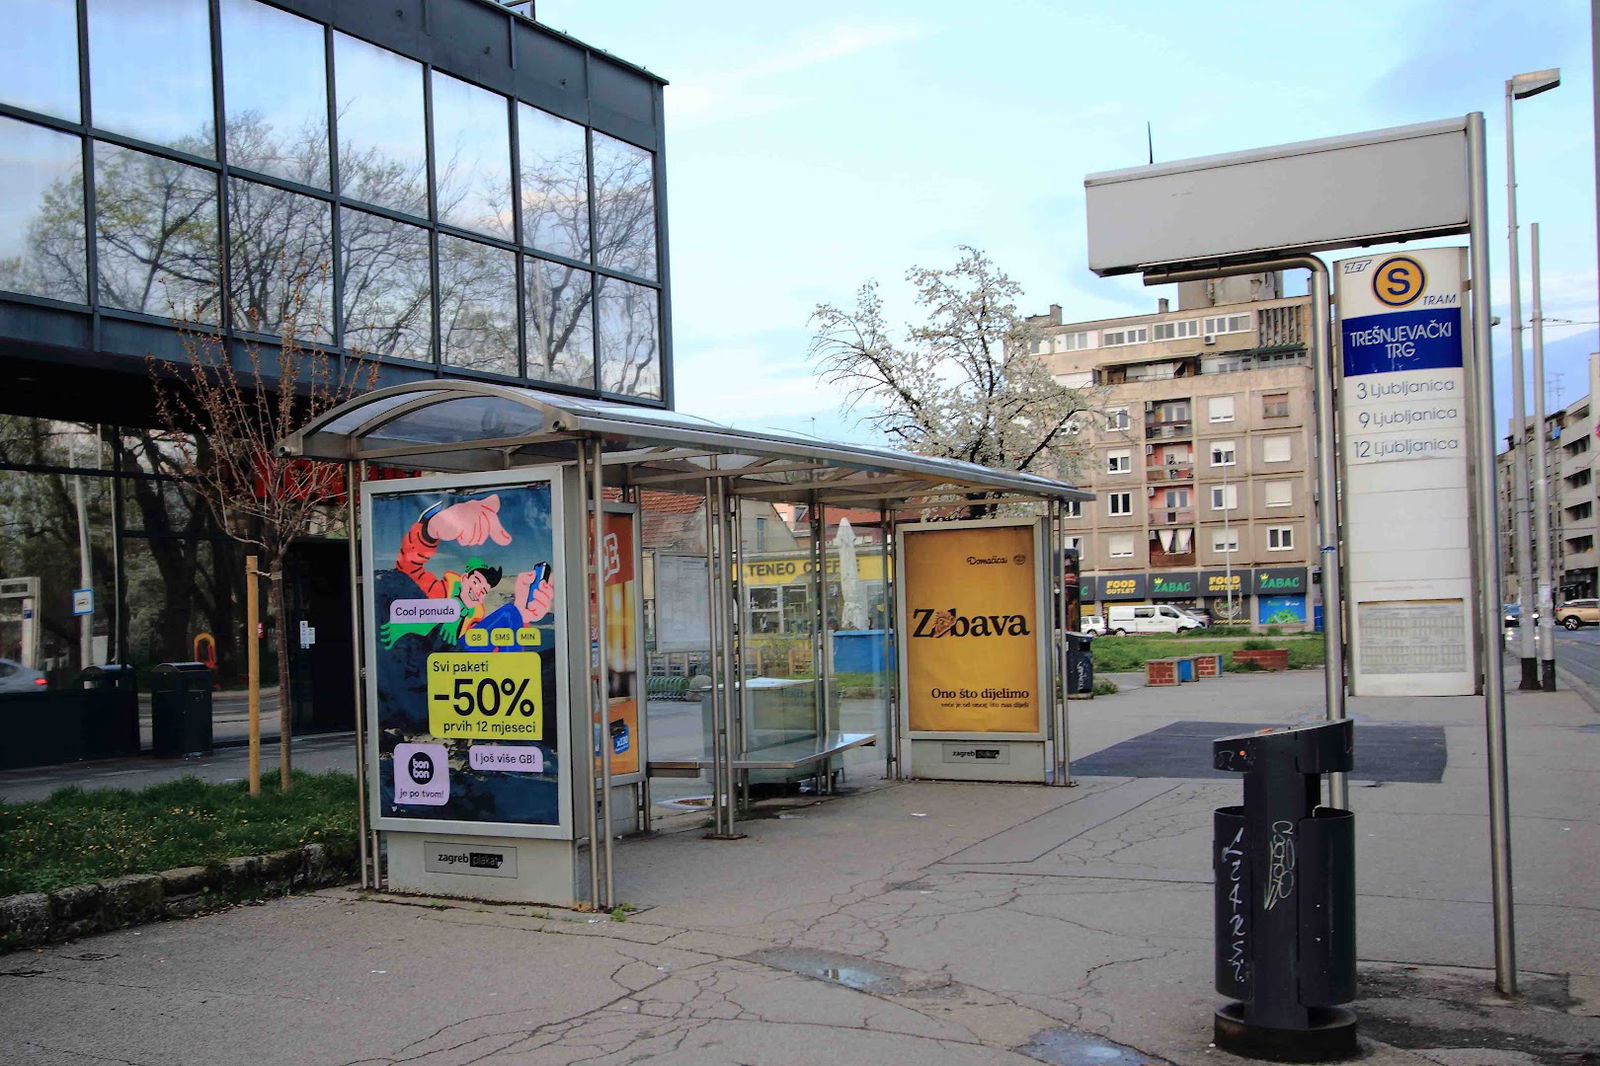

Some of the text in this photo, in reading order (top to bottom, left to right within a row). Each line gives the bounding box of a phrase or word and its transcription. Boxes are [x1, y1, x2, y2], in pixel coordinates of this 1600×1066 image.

[1386, 267, 1411, 296] S
[1422, 294, 1457, 306] TRAM
[1349, 319, 1452, 347] TREŠNJEVAČKI
[1385, 341, 1416, 359] TRG
[1356, 379, 1455, 400] 3 Ljubljanica
[1358, 407, 1457, 430] 9 Ljubljanica
[1353, 439, 1458, 459] 12 Ljubljanica
[748, 559, 861, 577] TENEO COFF
[1106, 579, 1136, 589] FOOD
[395, 605, 455, 618] Cool ponuda
[912, 608, 1031, 638] Zbava
[471, 634, 482, 642] GB
[494, 633, 510, 641] SMS
[520, 633, 536, 641] MIN
[433, 660, 489, 675] Svi paketi
[433, 677, 535, 717] -50%
[931, 687, 1029, 700] Ono što dijelimo
[443, 721, 536, 735] prvih 12 mjeseci
[412, 758, 430, 769] bon
[480, 753, 495, 765] još
[497, 754, 516, 764] više
[518, 754, 536, 764] GB!
[412, 769, 430, 779] bon
[399, 788, 445, 799] je po tvom!
[438, 853, 469, 864] zagreb
